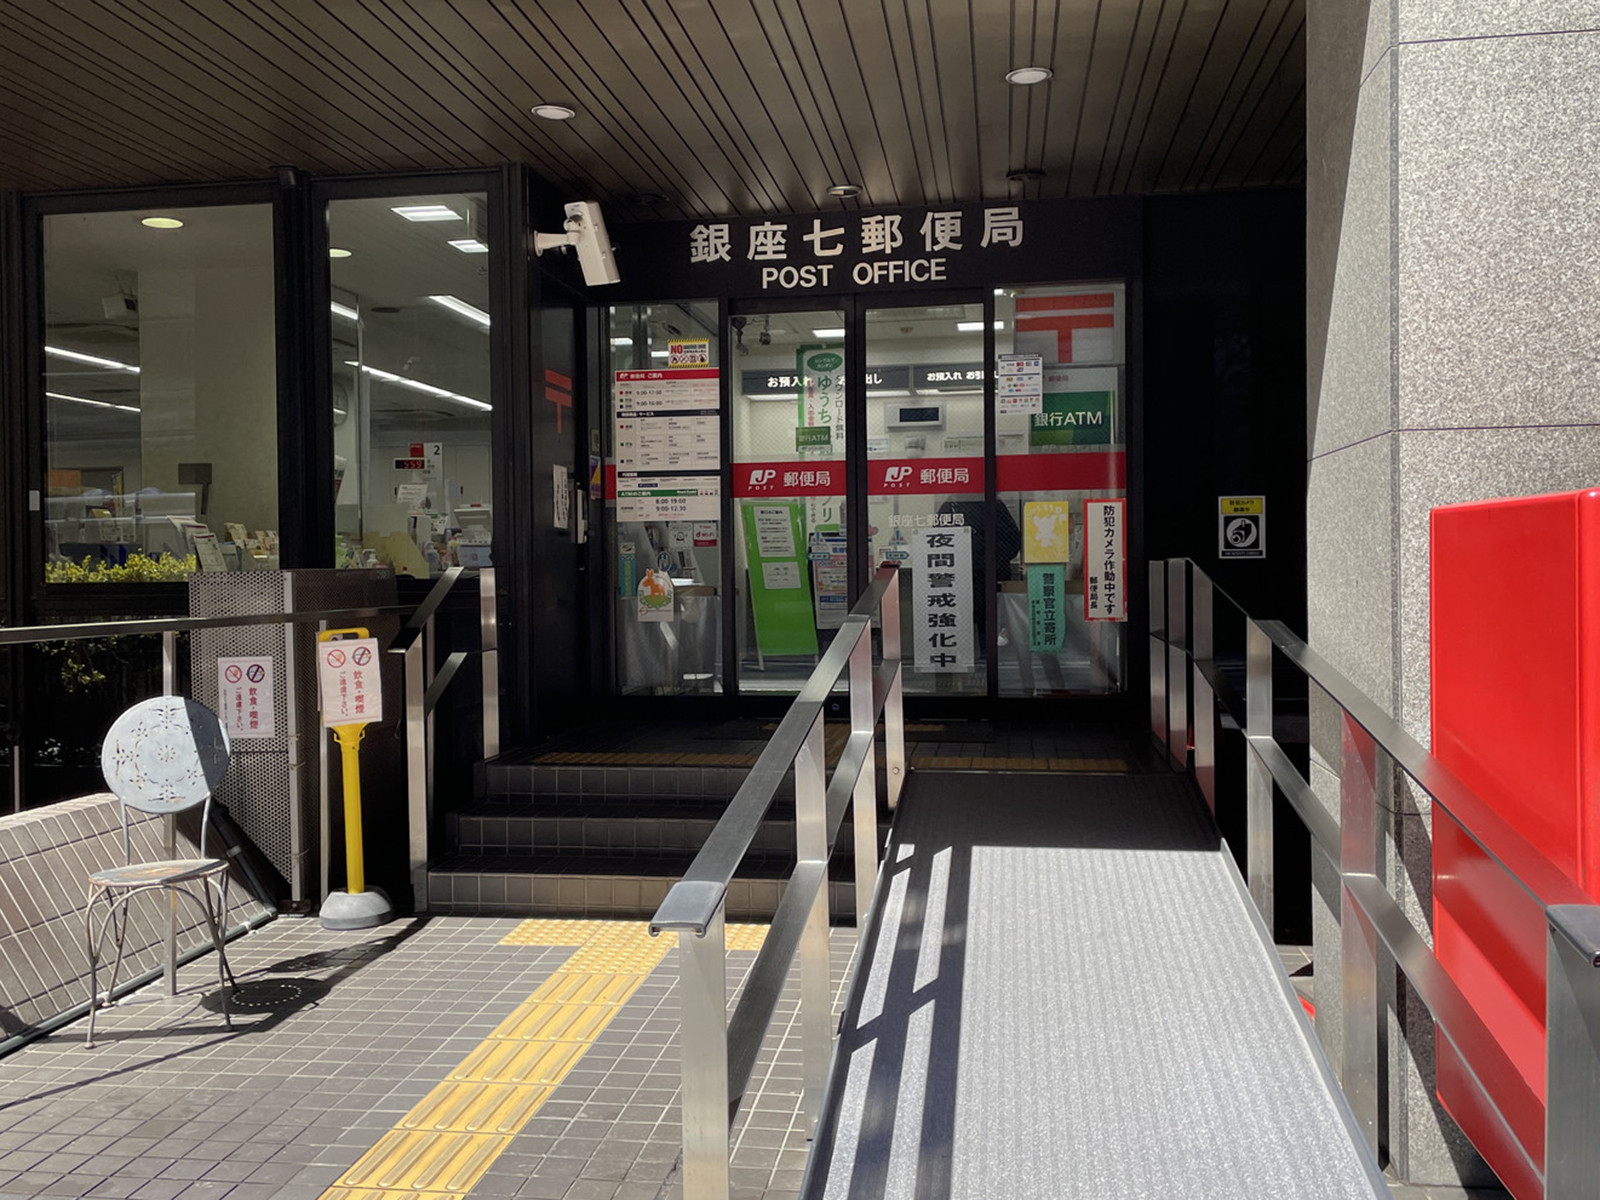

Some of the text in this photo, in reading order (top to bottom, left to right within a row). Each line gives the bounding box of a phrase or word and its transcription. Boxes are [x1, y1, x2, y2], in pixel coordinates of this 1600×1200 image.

[690, 206, 1024, 263] 銀座七郵便局
[761, 257, 948, 290] POST OFFICE
[1033, 410, 1103, 427] 銀行ATM
[433, 445, 441, 456] 2
[783, 470, 831, 488] 郵便局
[920, 467, 969, 484] 郵便局
[888, 513, 965, 527] 銀座七郵便局
[1103, 505, 1116, 616] 防犯カメラ作動中です
[926, 532, 957, 668] 夜間警戒強化中
[1042, 572, 1057, 646] 警察官立寄所
[1089, 576, 1099, 610] 郵便局長
